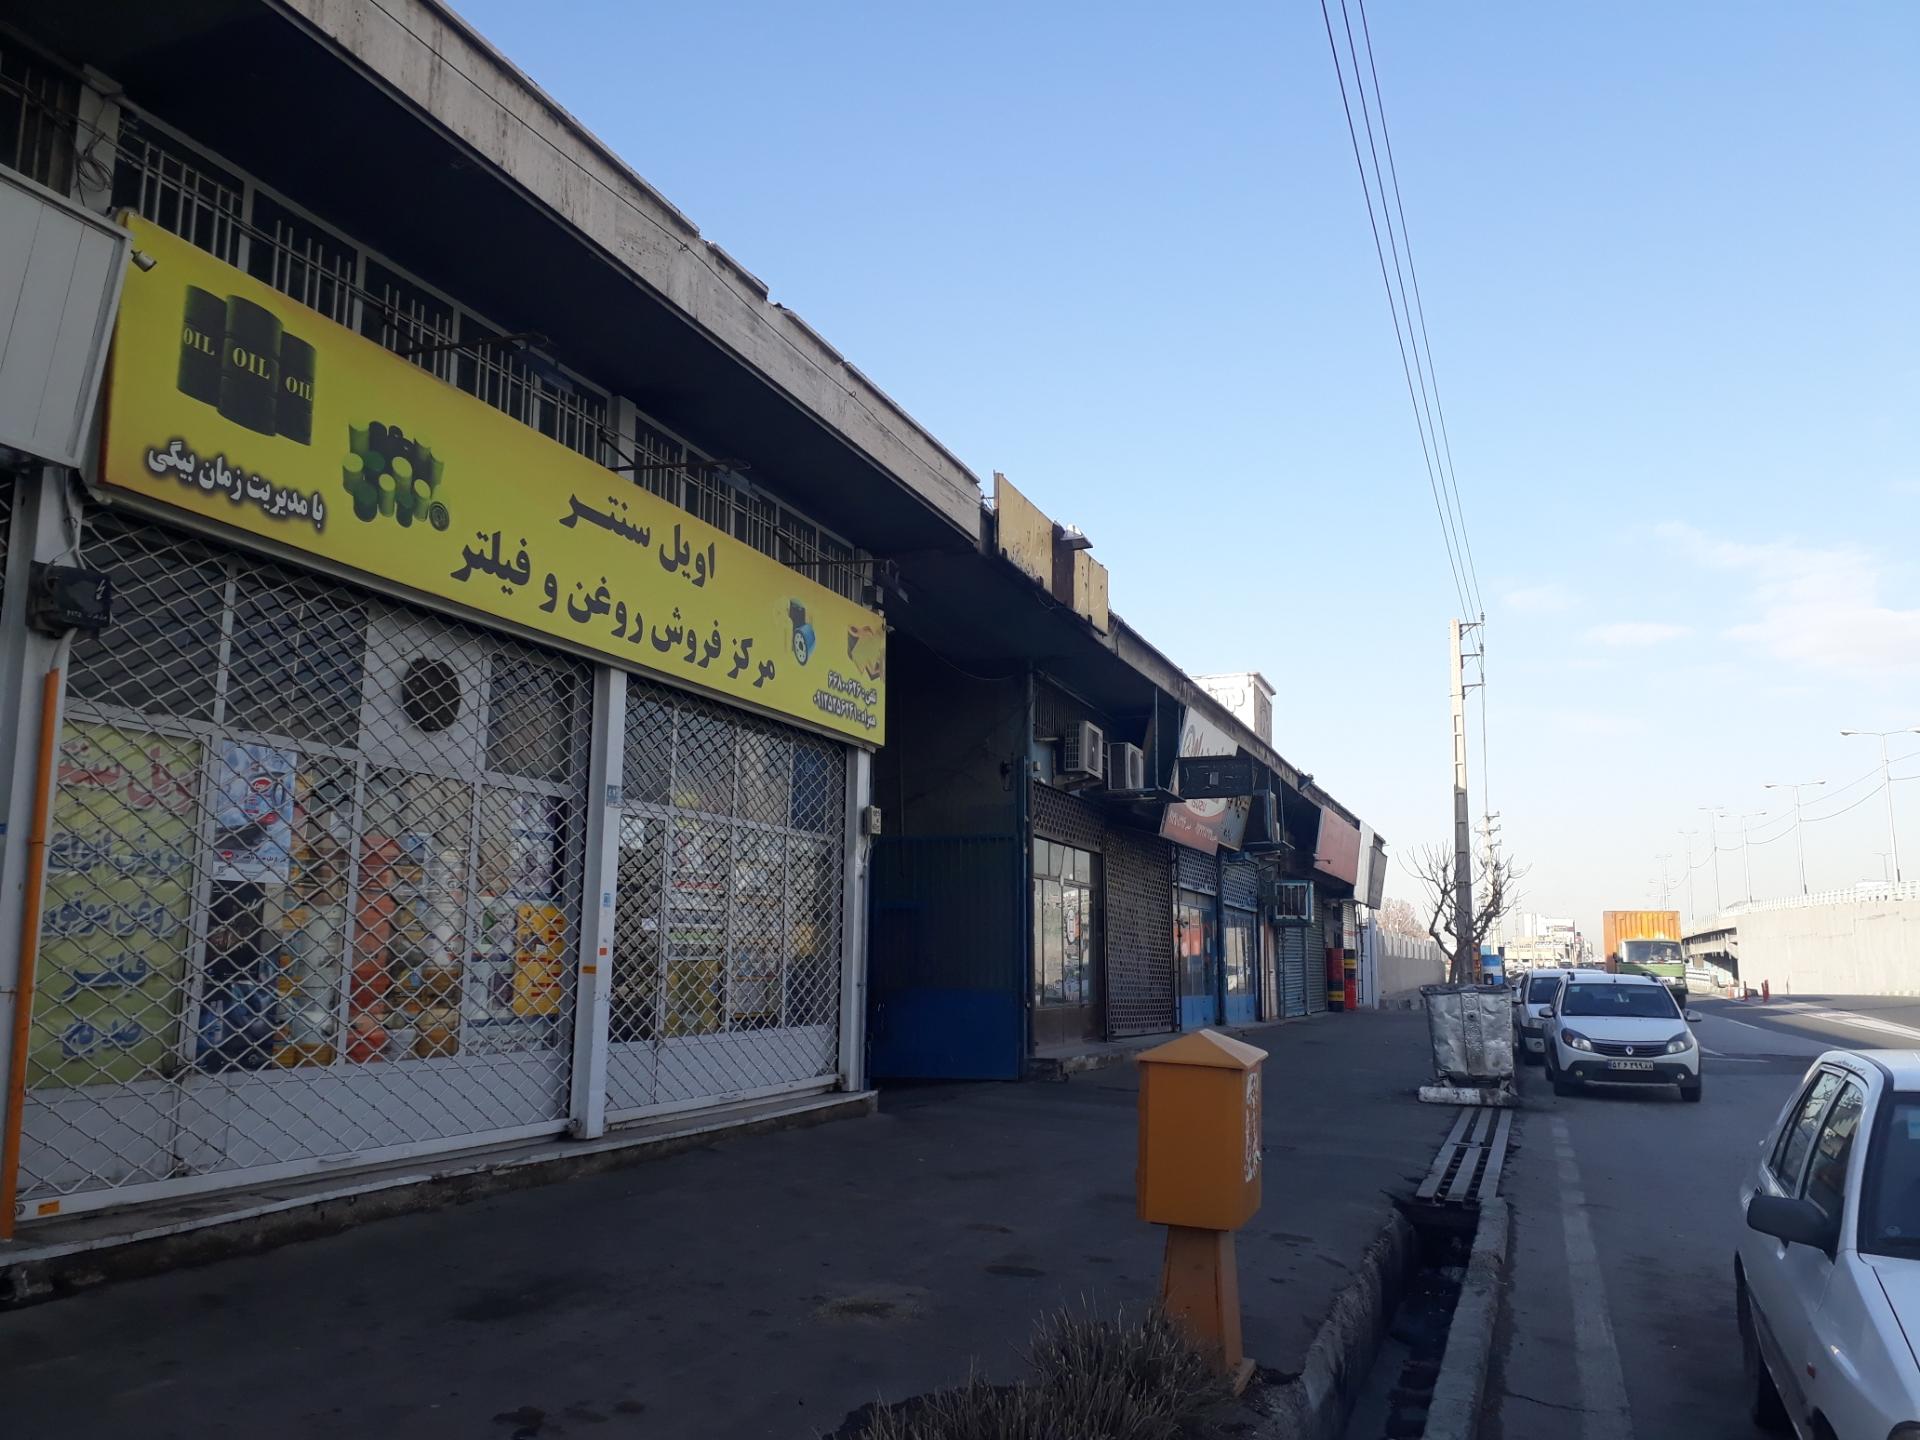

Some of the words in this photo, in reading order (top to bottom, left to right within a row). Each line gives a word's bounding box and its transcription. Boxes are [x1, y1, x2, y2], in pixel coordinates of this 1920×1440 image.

[183, 327, 215, 356] OIL
[232, 347, 270, 380] OIL
[285, 376, 313, 402] OIL
[148, 440, 196, 482] بیگی
[199, 456, 242, 501] زمان
[246, 475, 308, 516] مدیریت
[311, 491, 324, 528] با
[558, 493, 651, 548] سنتر
[450, 530, 531, 596] فیلتر
[658, 523, 716, 588] اویل
[538, 572, 558, 614] و
[566, 575, 644, 644] روغن
[650, 606, 722, 669] فروش
[726, 637, 776, 689] مرکز
